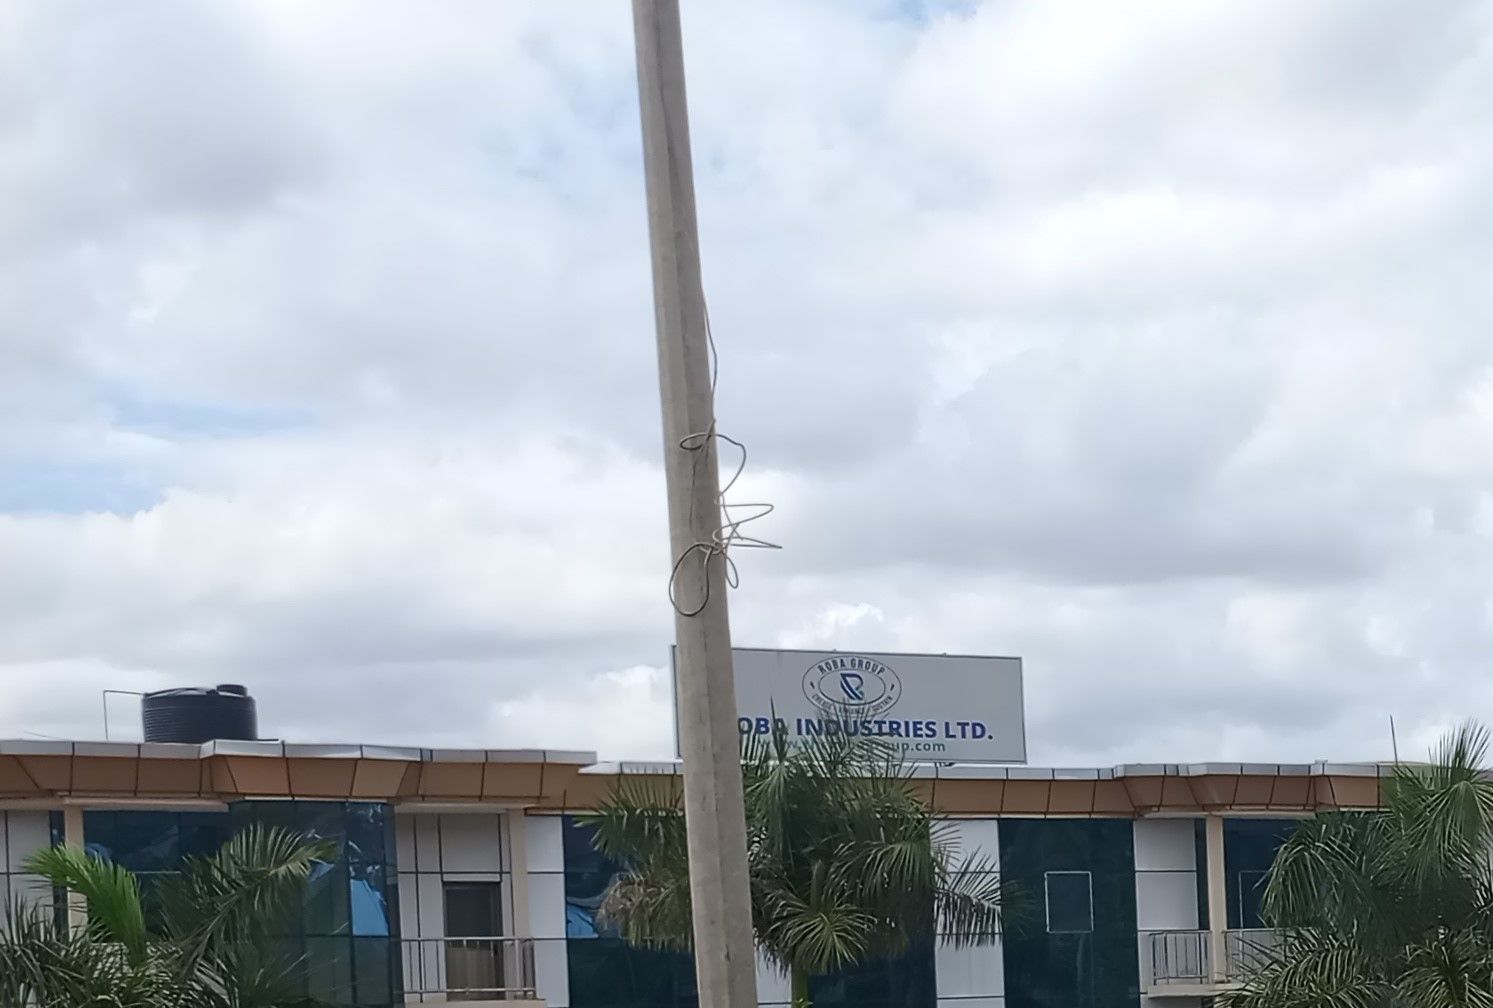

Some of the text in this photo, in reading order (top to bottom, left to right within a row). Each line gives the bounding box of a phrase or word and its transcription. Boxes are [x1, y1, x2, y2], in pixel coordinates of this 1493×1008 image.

[737, 716, 994, 741] OBA INDUSTRIES LTD.
